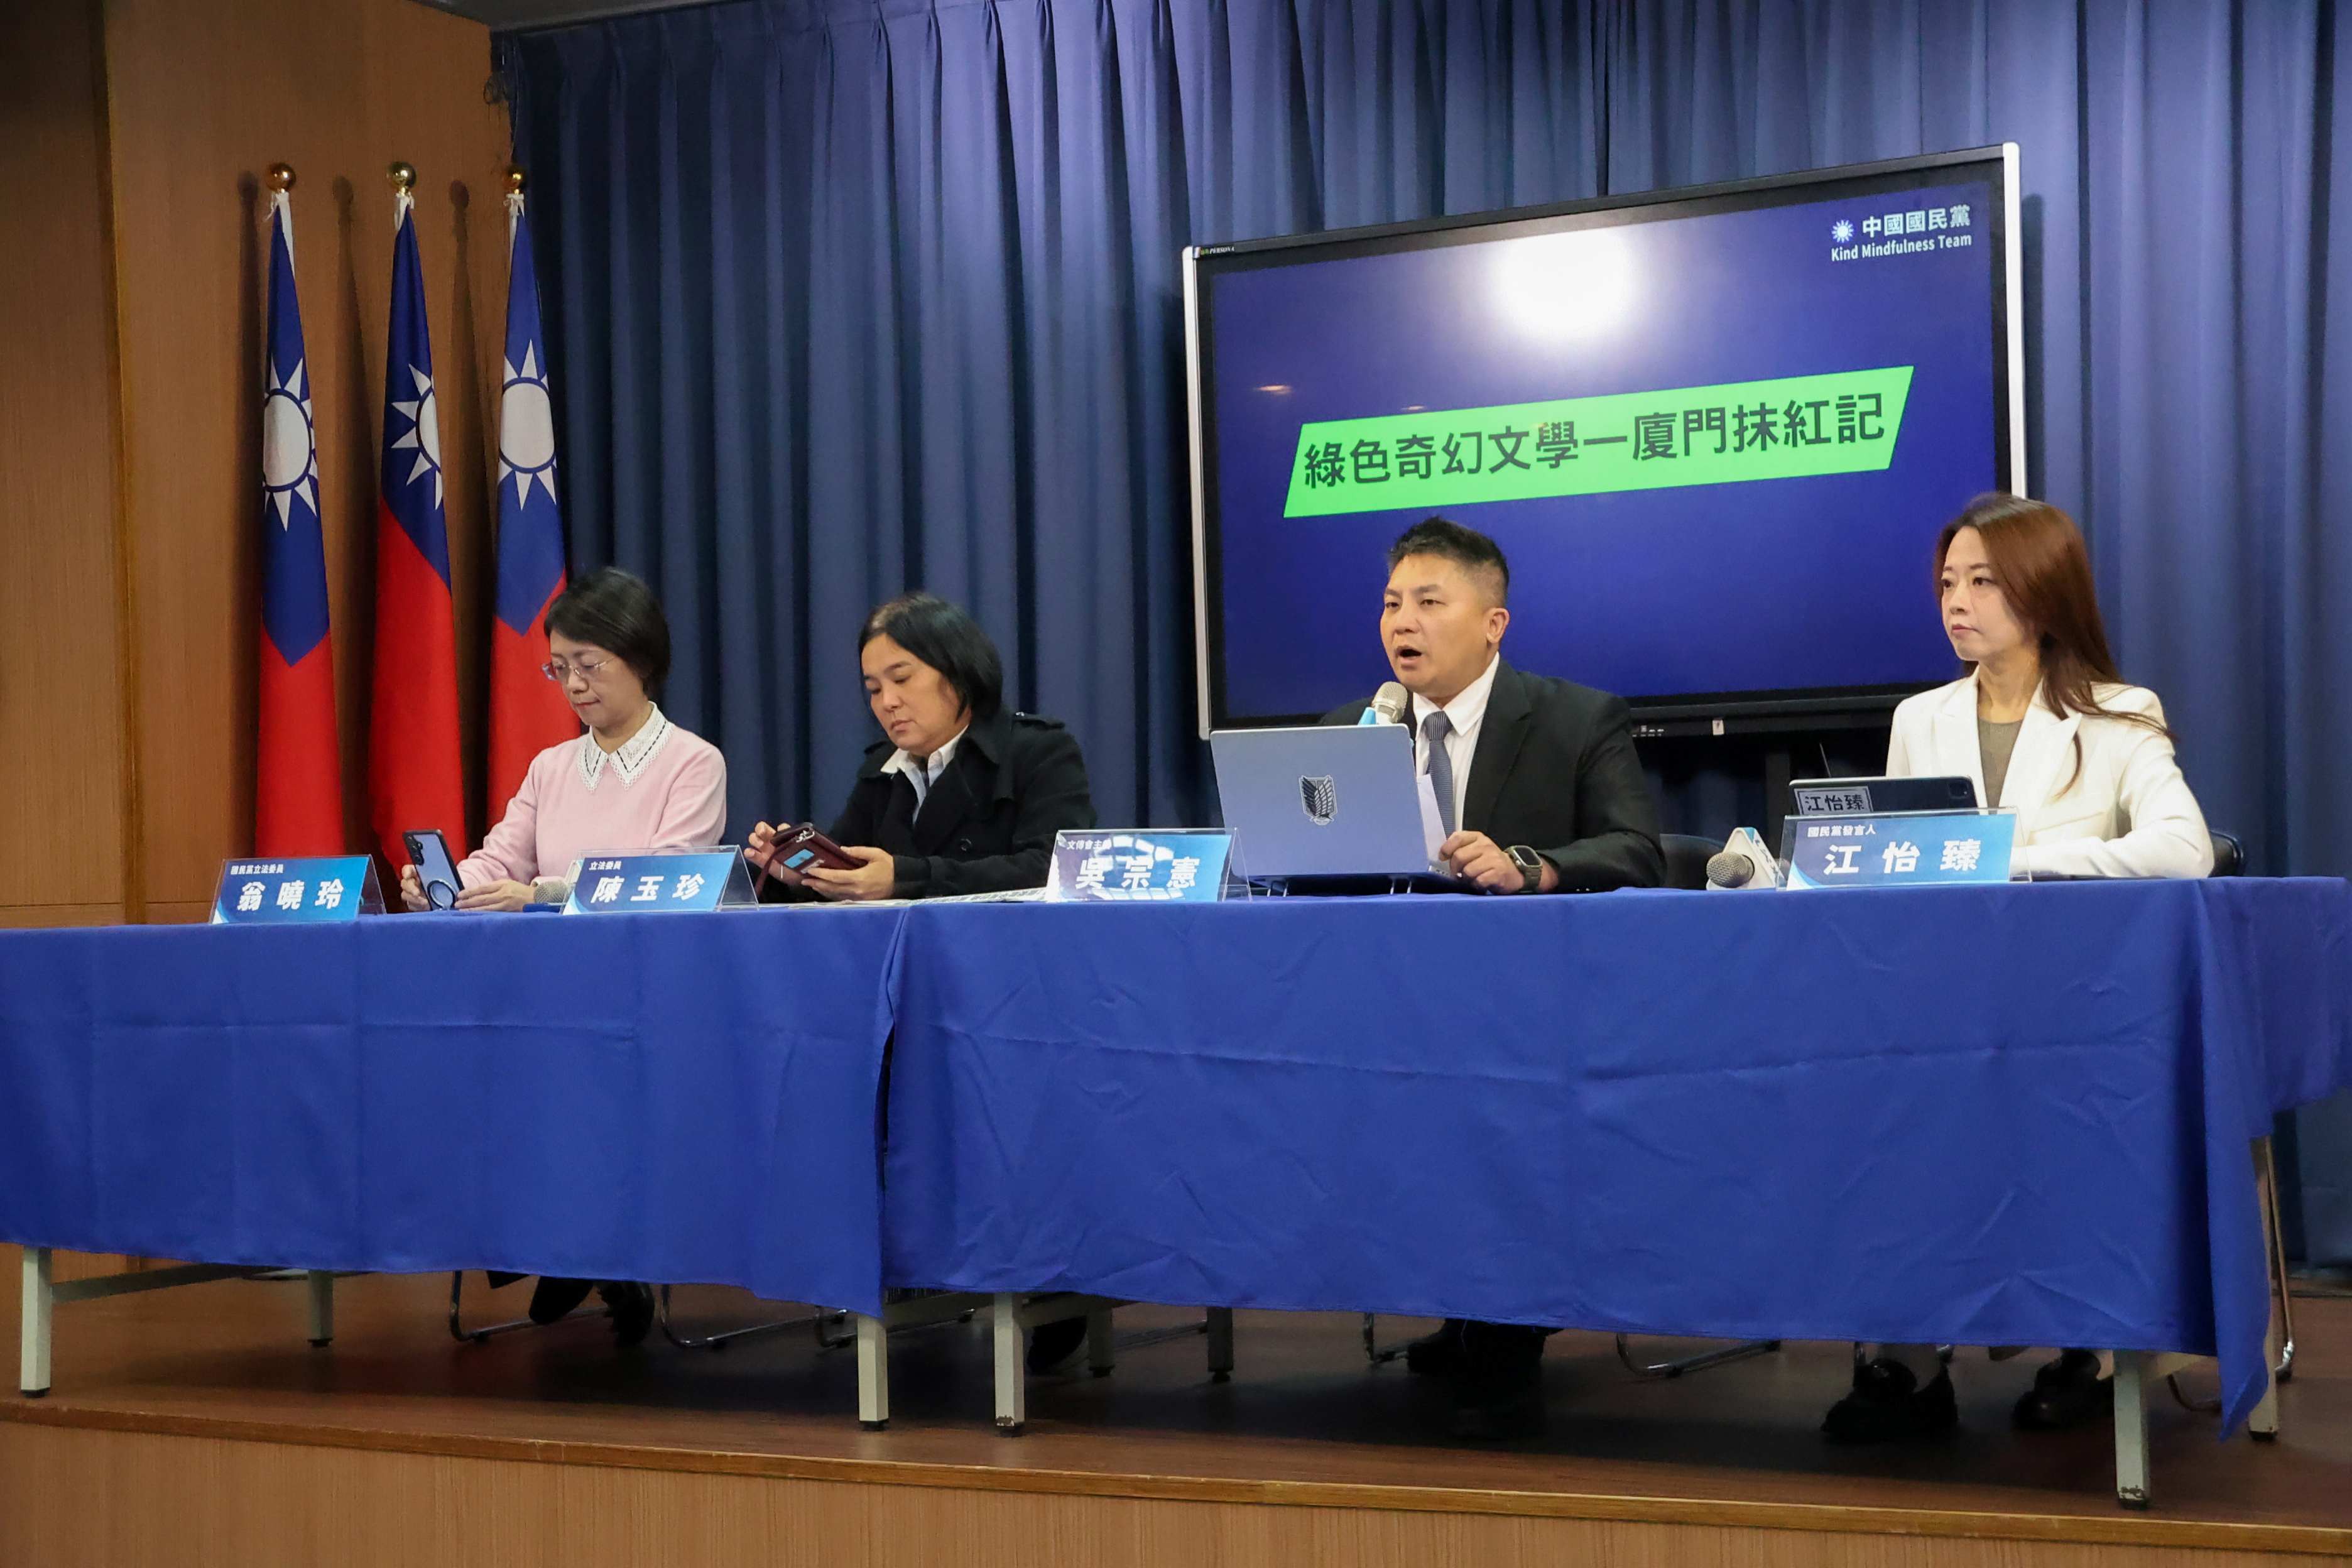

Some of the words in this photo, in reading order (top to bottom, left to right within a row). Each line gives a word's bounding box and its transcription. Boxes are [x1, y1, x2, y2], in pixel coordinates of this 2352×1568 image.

[1862, 204, 1971, 238] 中國國民黨
[1831, 244, 1858, 262] Kind
[1862, 238, 1935, 258] Mindfulness
[1937, 234, 1972, 249] Team
[1804, 793, 1865, 812] 江怡臻
[1807, 824, 1876, 837] 國民黨發言人
[230, 864, 284, 875] 國民黨立法委員
[588, 860, 622, 871] 立法委員
[1823, 838, 1981, 876] 江怡臻
[236, 878, 344, 912] 翁曉玲
[590, 873, 705, 903] 陳玉珍
